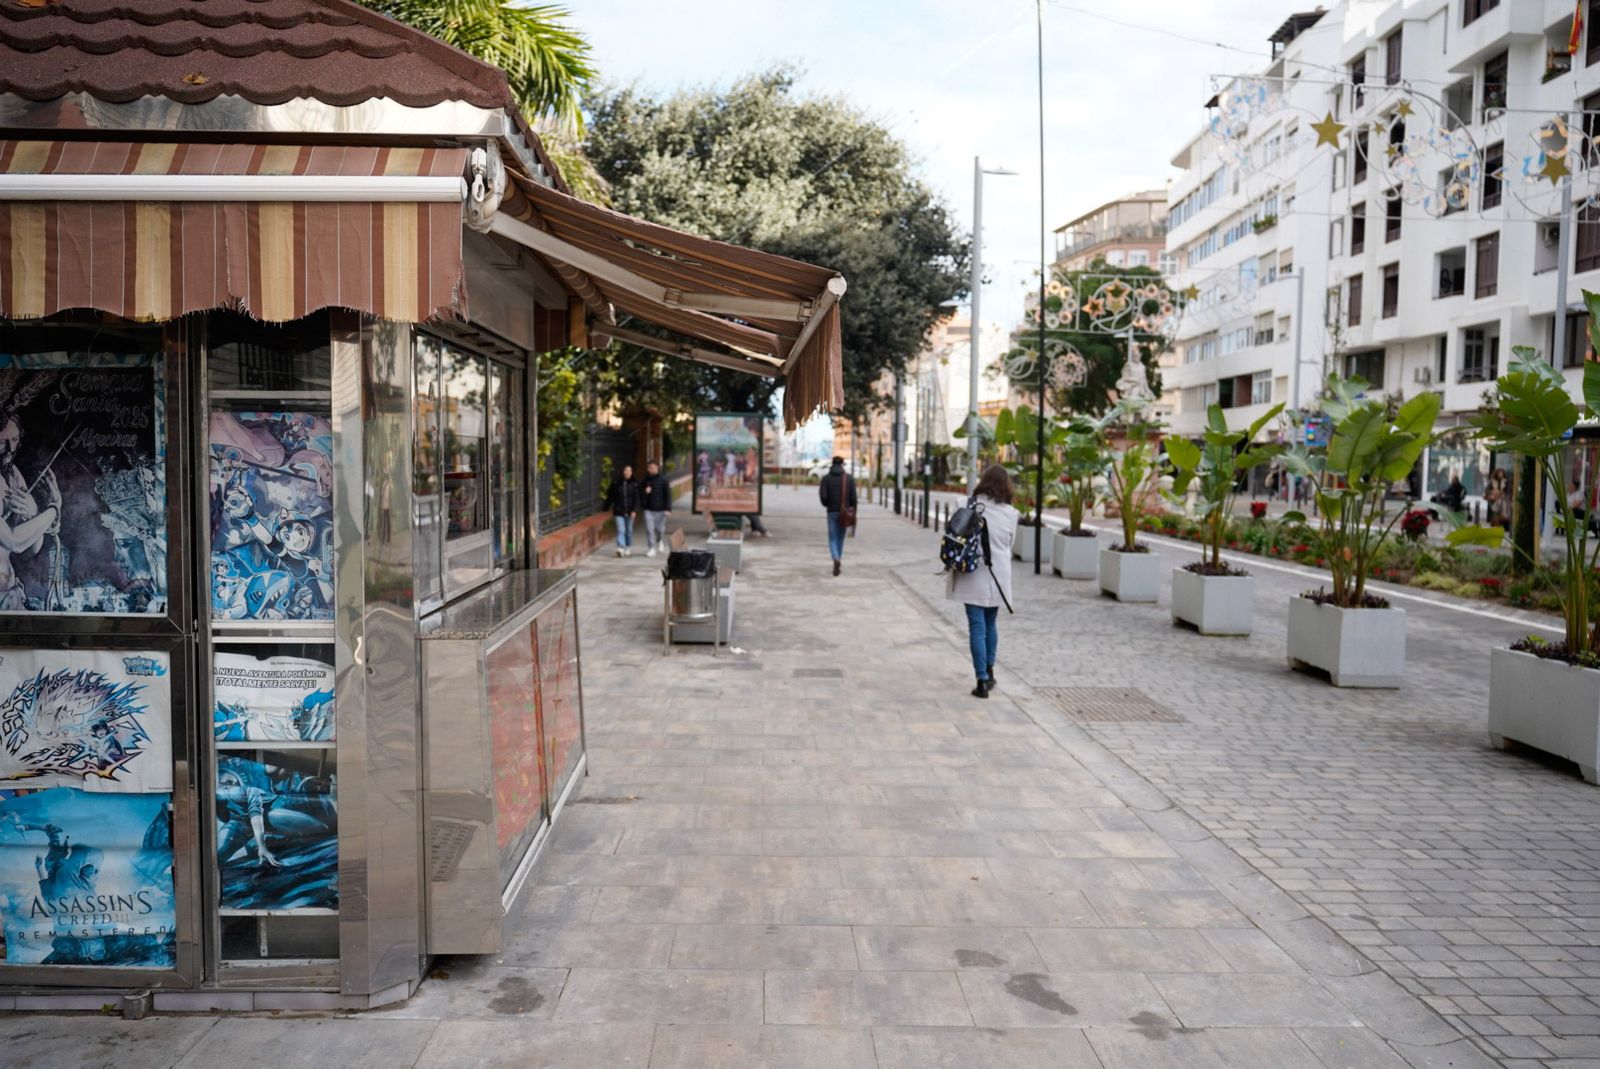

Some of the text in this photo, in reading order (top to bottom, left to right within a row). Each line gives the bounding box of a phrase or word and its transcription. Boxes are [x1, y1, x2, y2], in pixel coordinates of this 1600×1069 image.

[60, 372, 144, 398] Semana
[49, 393, 119, 416] Santa
[111, 405, 149, 428] 2025
[219, 667, 246, 677] NUEVA
[246, 669, 286, 679] AVENTURA
[287, 668, 327, 679] POKÉMON:
[279, 679, 317, 690] SALVAJE!
[30, 890, 153, 919] ASSASSIN'S
[57, 913, 113, 926] CREED
[18, 925, 166, 940] REMASTERED
